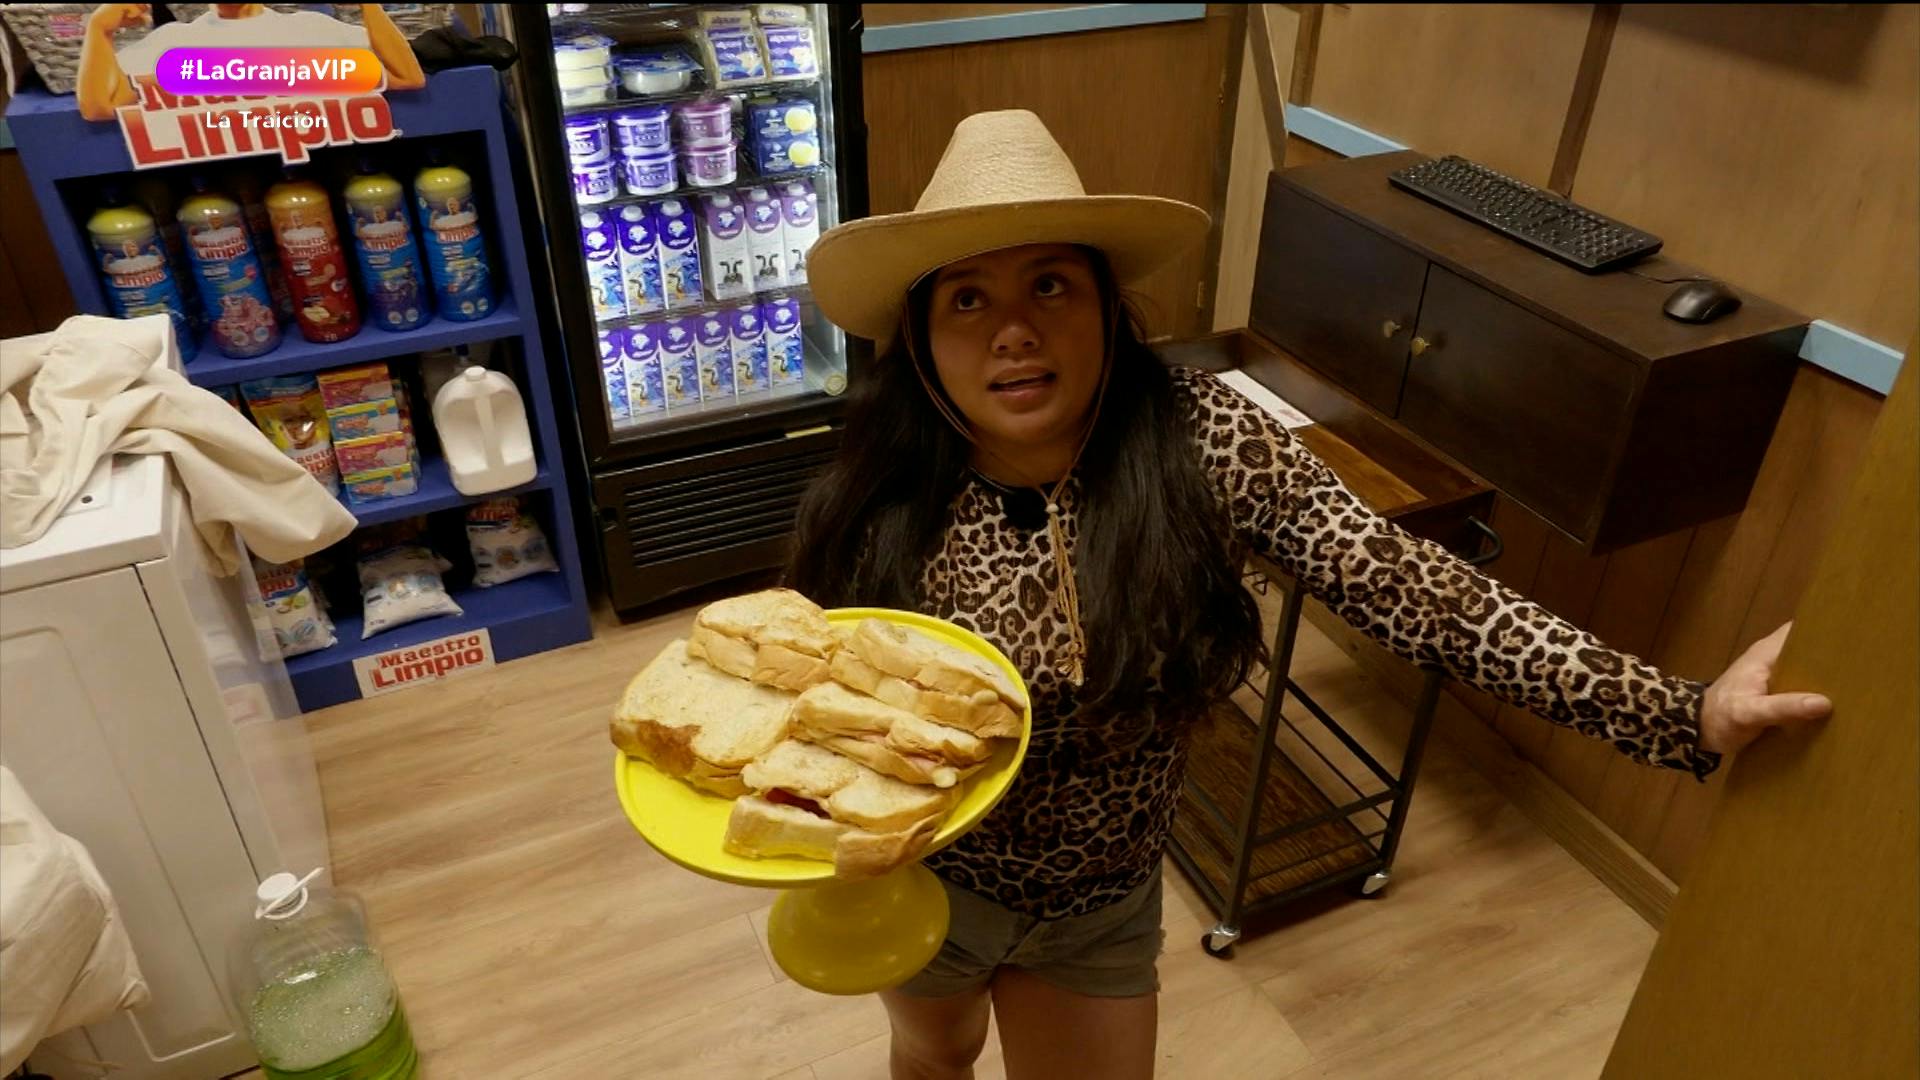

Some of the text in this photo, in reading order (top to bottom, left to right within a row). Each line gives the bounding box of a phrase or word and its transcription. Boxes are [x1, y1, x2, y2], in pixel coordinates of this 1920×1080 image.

[121, 95, 394, 165] Limpio
[373, 648, 484, 688] Limpio
[380, 635, 481, 669] Maestro
